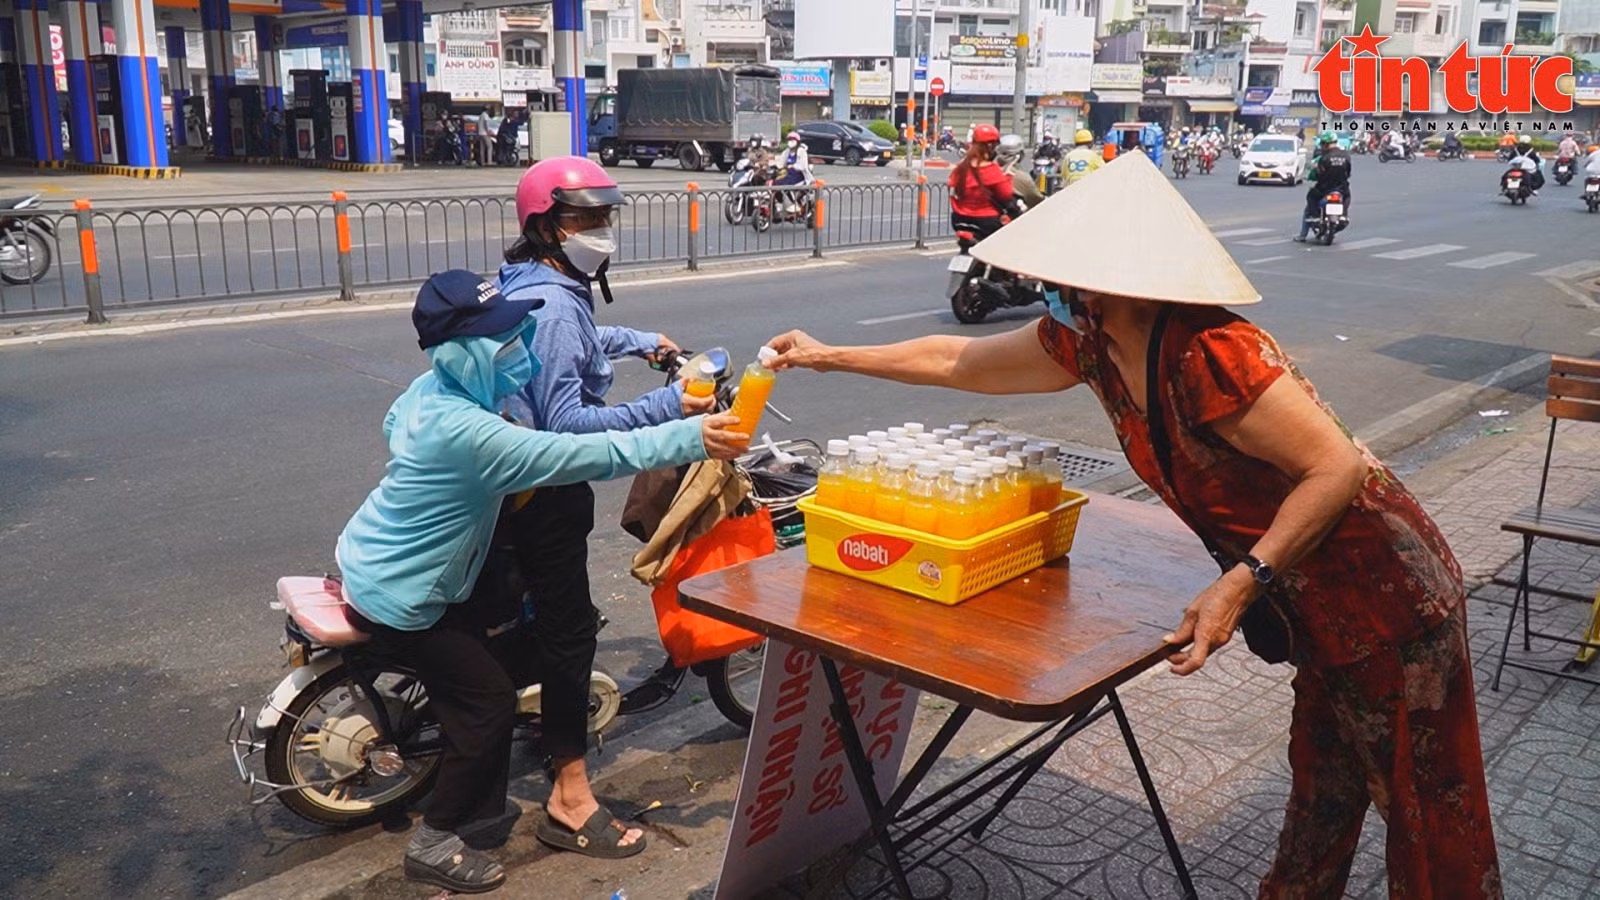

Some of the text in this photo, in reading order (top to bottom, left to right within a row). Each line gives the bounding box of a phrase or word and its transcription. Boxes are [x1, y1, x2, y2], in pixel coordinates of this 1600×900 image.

[445, 60, 465, 69] ANH
[1275, 118, 1300, 126] PUMA
[1069, 160, 1089, 172] be
[843, 538, 889, 565] nabati
[744, 646, 817, 848] GHI NHẬN
